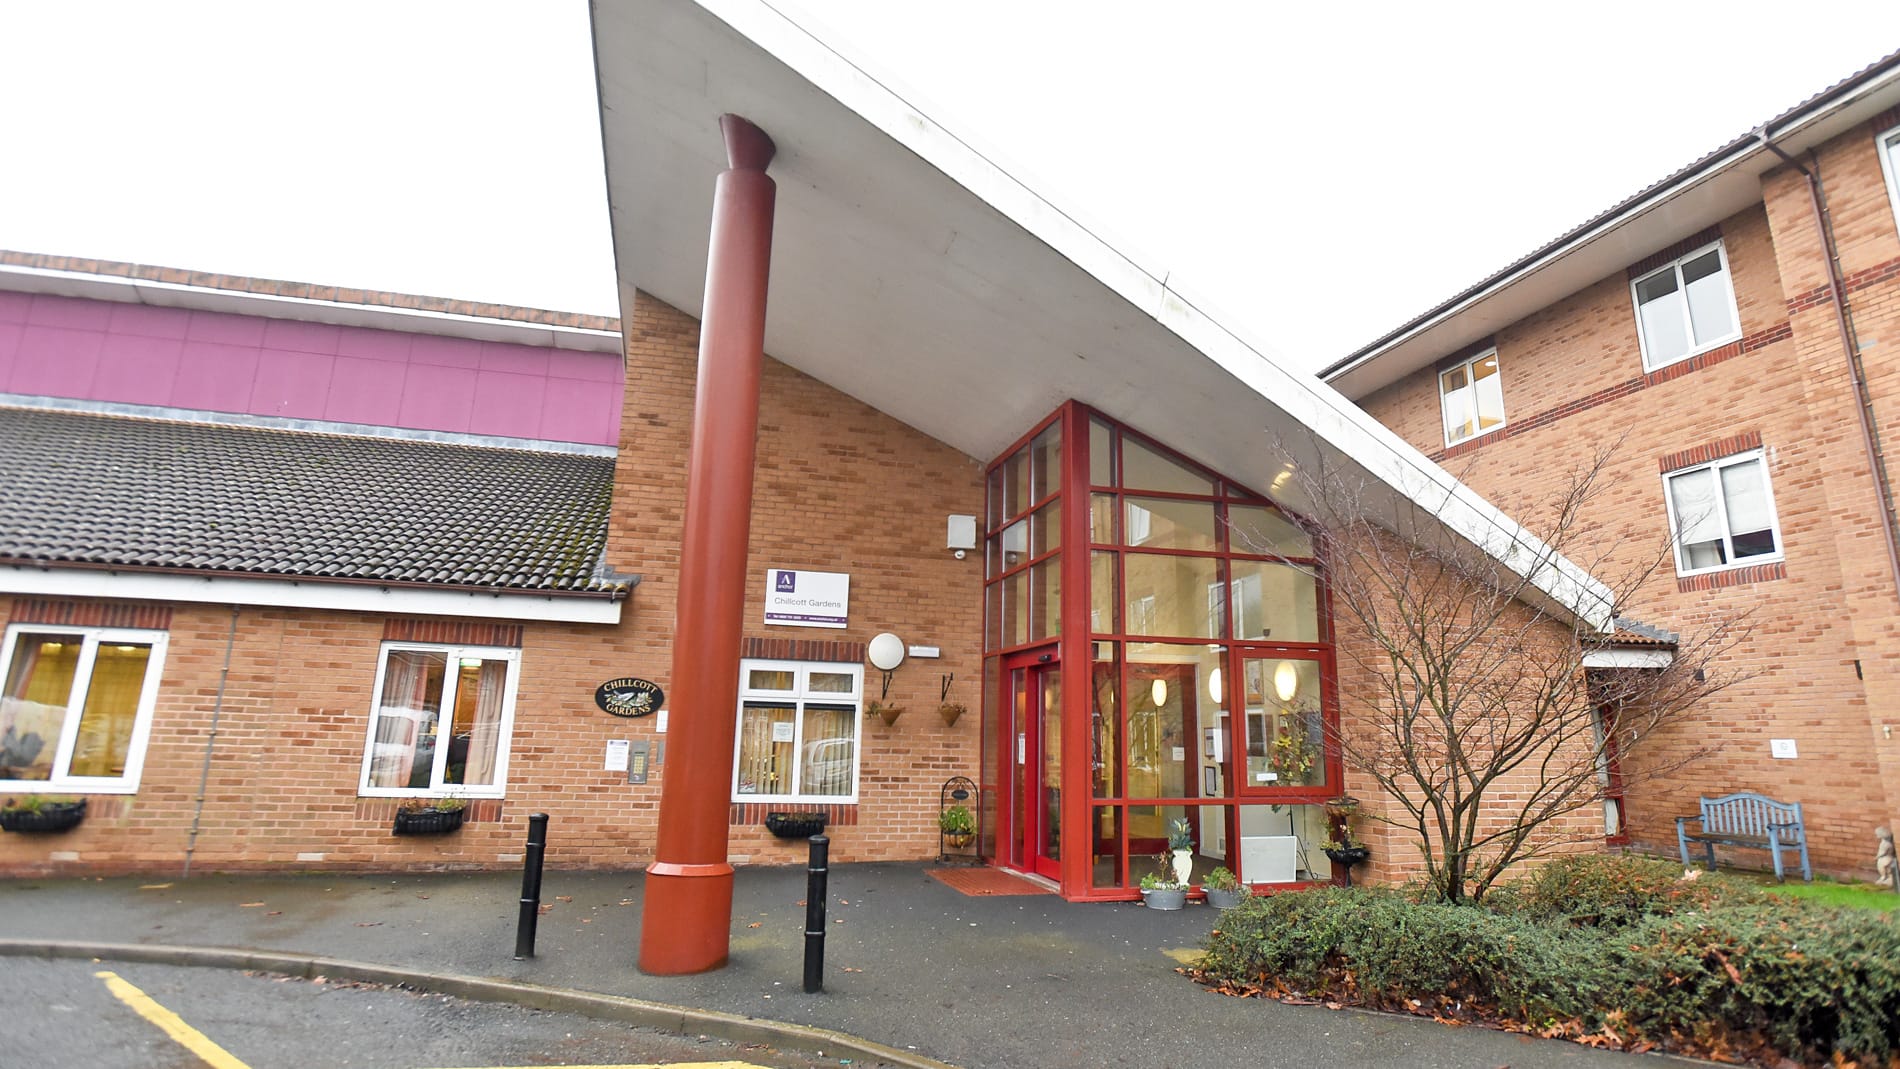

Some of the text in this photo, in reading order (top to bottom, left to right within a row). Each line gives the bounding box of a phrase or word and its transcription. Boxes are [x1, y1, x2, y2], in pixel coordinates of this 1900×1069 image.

[774, 597, 841, 608] Chillcott Gardens
[603, 679, 657, 693] CHILLCOTT
[606, 703, 651, 715] GARDENS
